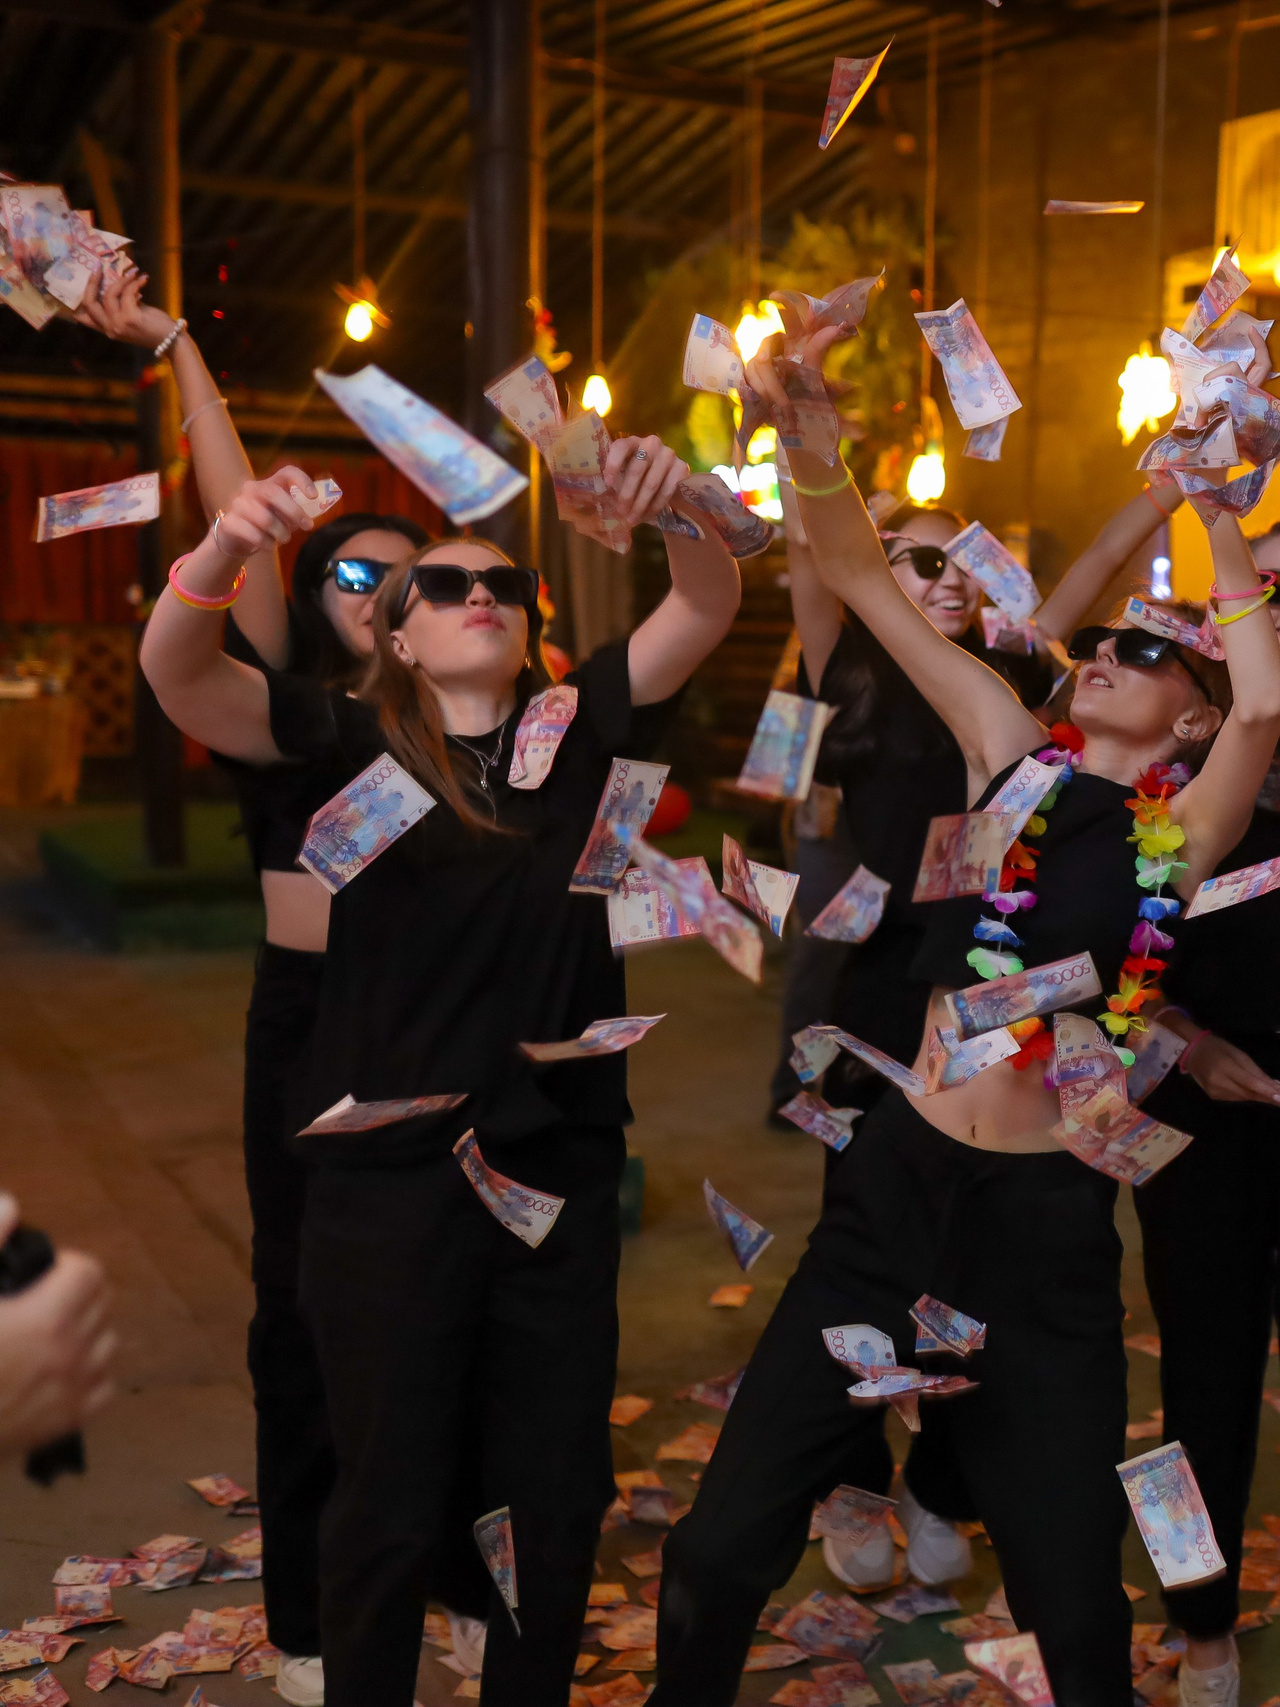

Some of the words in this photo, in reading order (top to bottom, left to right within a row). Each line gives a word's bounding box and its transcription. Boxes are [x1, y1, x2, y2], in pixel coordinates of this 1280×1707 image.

[989, 379, 1012, 411] 5000
[365, 761, 397, 791] 5000
[610, 762, 630, 801] 5000
[1014, 764, 1040, 792] 5000
[1051, 962, 1091, 985] 5000
[525, 1196, 558, 1216] 5000
[1194, 1534, 1216, 1569] 5000
